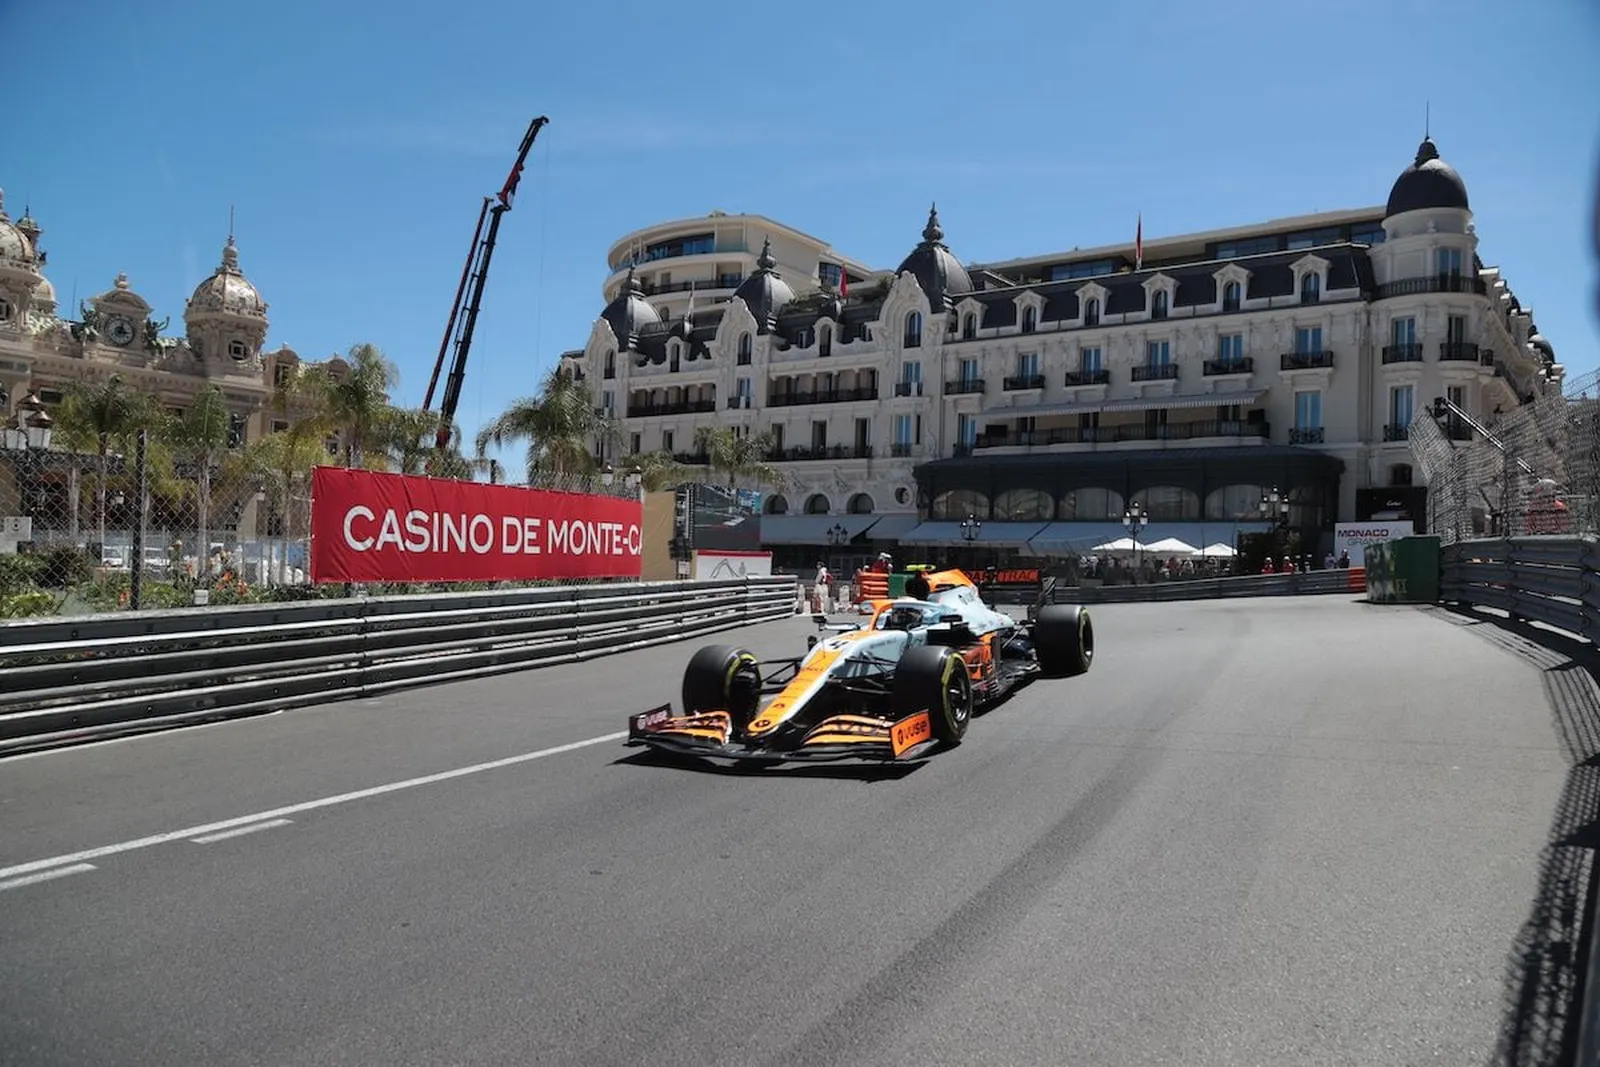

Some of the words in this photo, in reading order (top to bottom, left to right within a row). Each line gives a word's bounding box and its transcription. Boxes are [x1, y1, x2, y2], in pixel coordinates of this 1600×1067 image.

[343, 505, 494, 554] CASINO
[502, 516, 541, 554] DE
[1337, 529, 1389, 537] MONACO
